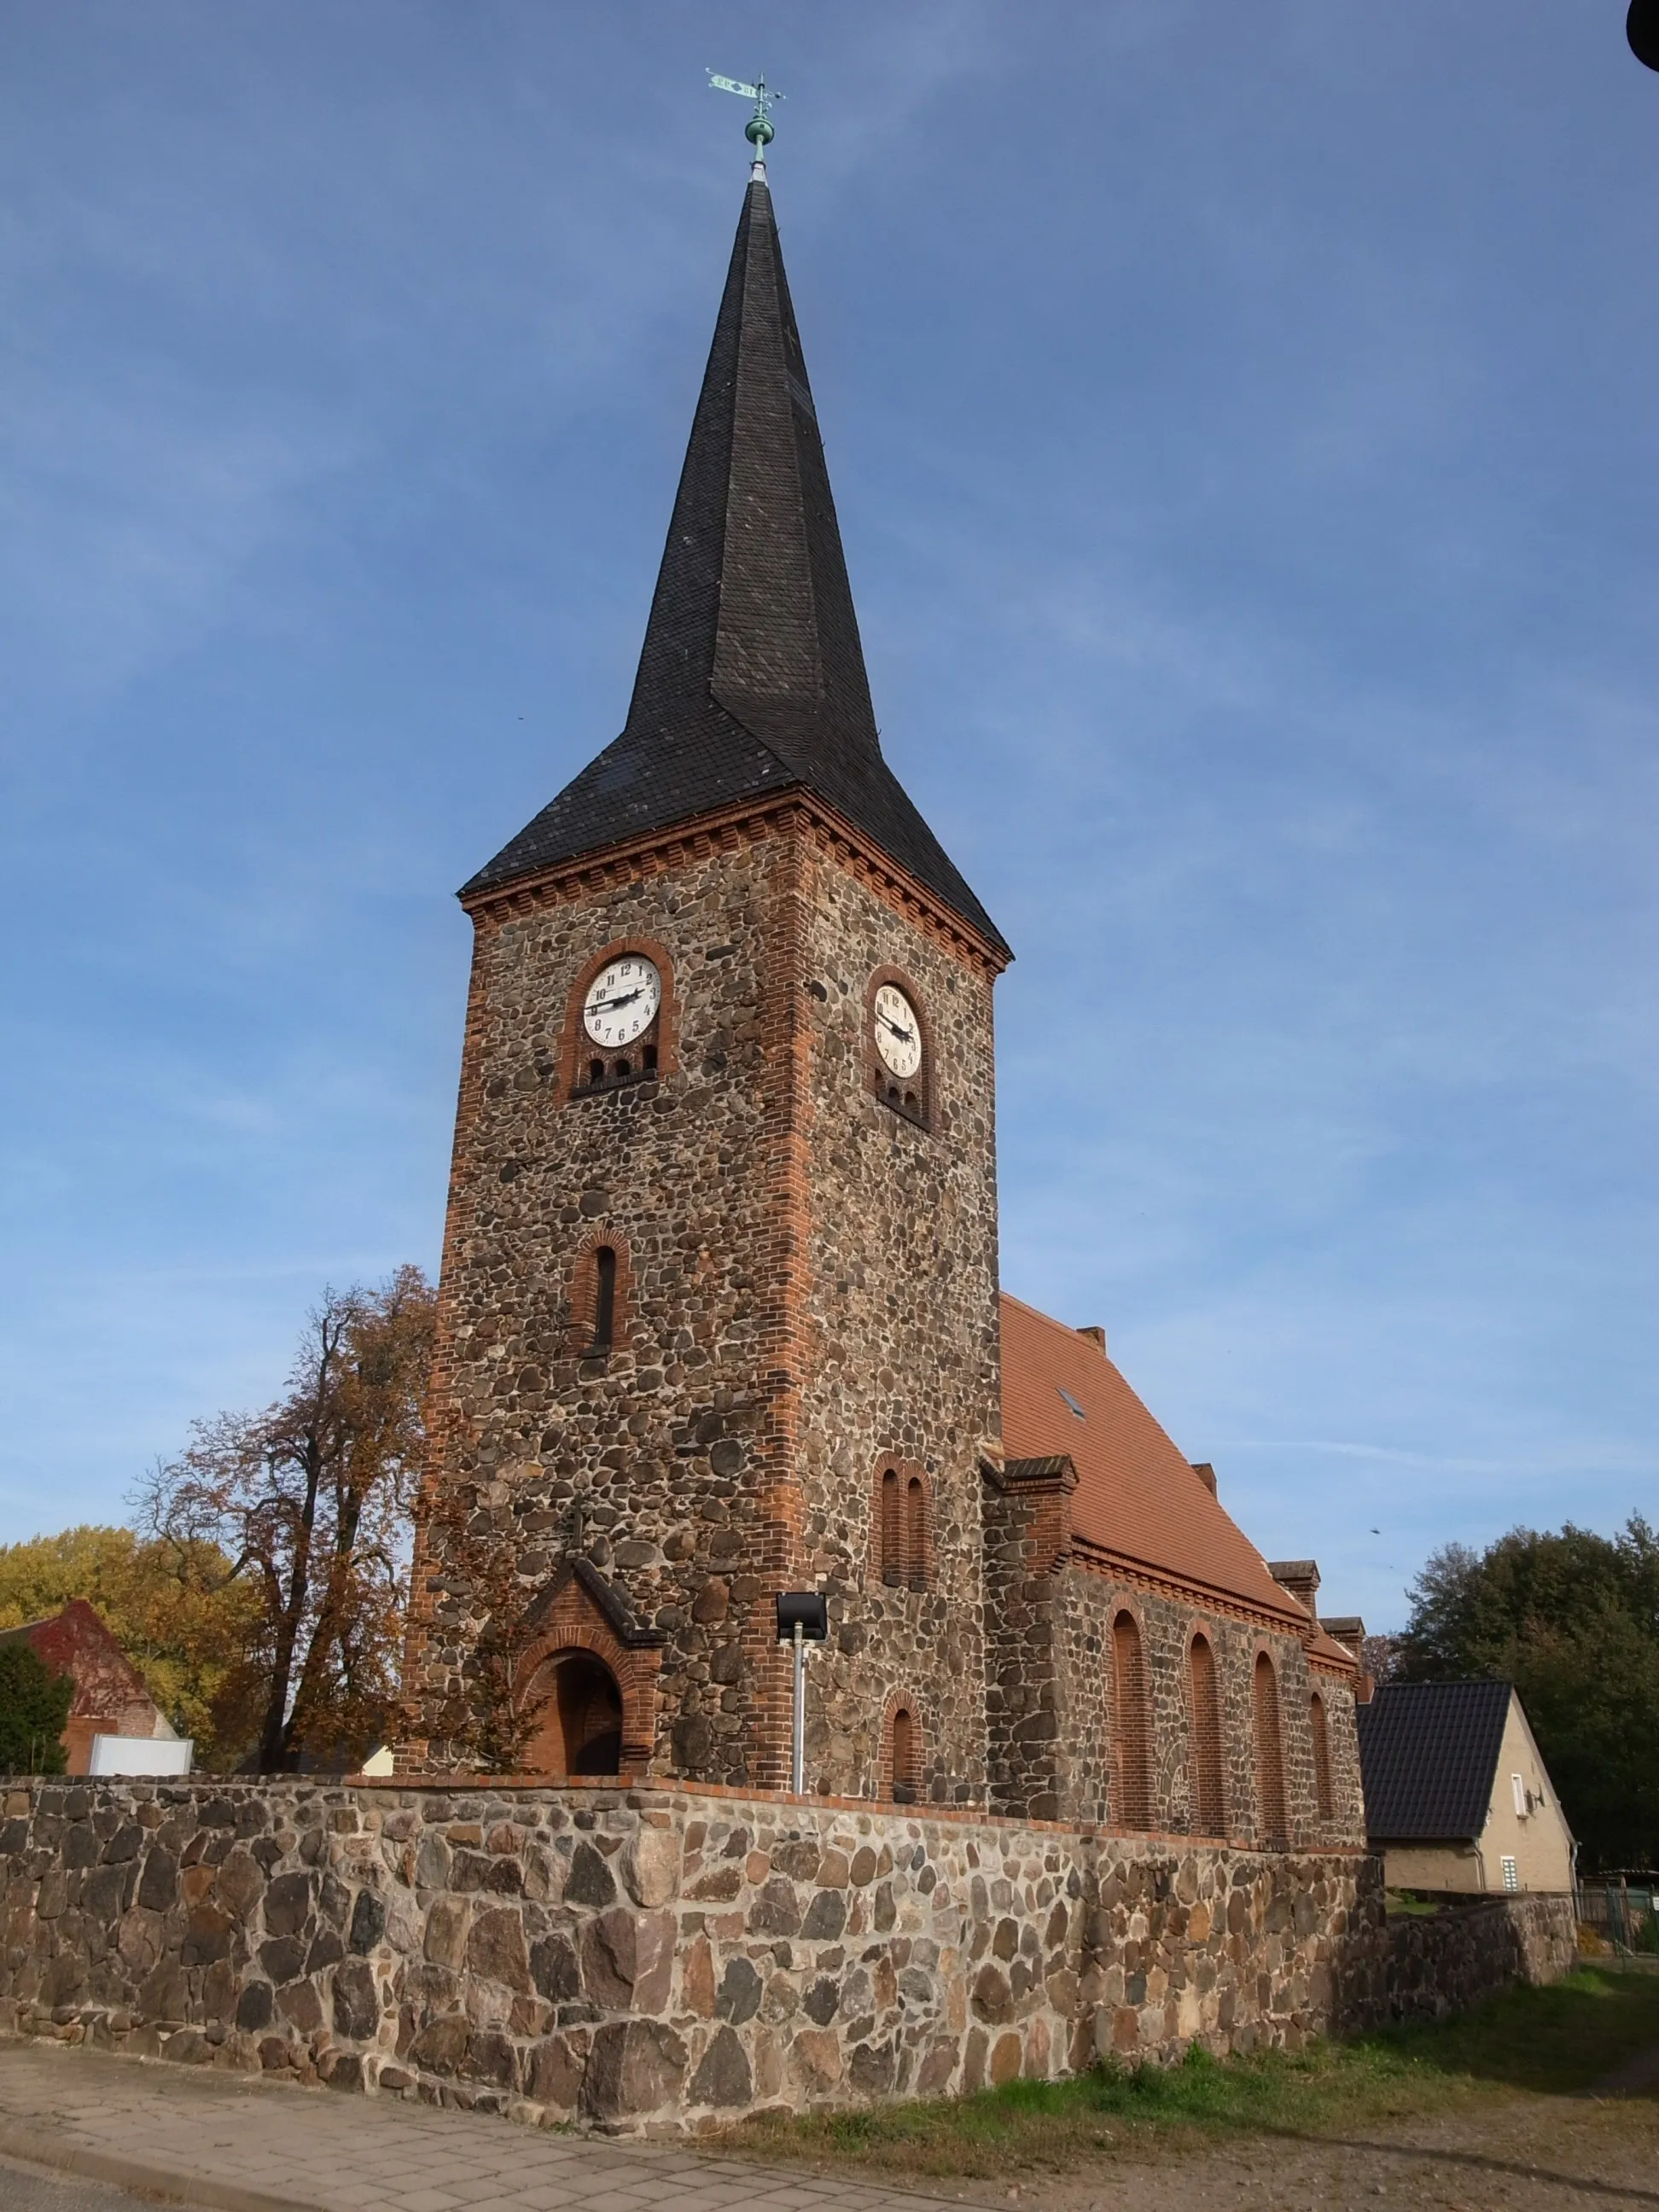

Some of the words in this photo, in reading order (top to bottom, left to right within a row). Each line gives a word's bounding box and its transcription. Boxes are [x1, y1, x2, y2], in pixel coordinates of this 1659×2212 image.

[620, 964, 631, 977] 12
[638, 965, 643, 976] 1
[607, 975, 614, 986] 11
[646, 973, 653, 986] 2
[596, 988, 606, 1001] 10
[649, 987, 656, 999] 3
[643, 1004, 650, 1016] 4
[595, 1019, 602, 1031] 8
[632, 1021, 639, 1032] 5
[604, 1027, 612, 1039] 7
[618, 1029, 625, 1040] 6
